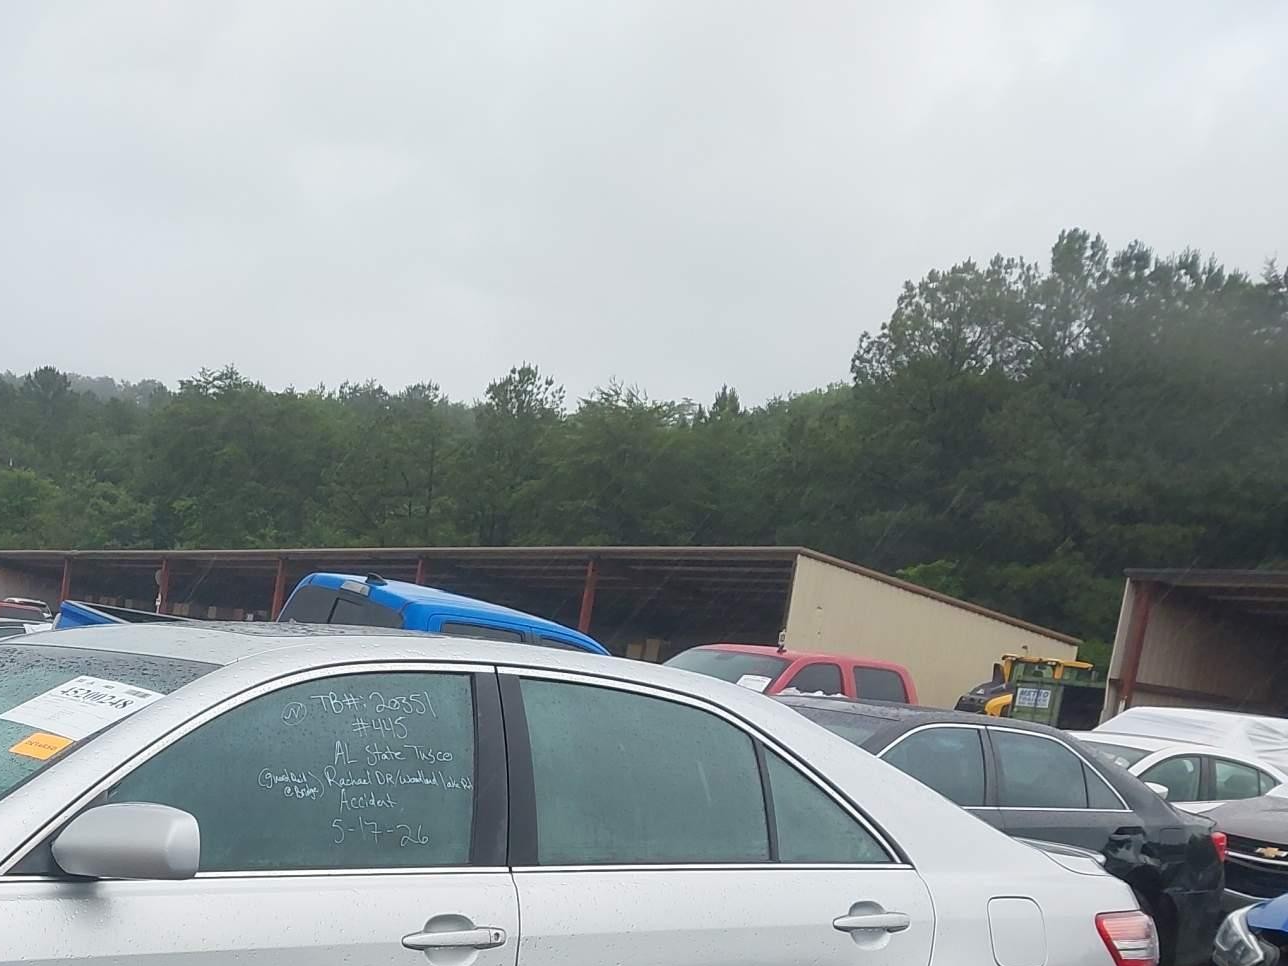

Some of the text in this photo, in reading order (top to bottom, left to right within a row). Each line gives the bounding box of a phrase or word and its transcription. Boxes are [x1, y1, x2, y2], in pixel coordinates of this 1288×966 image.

[369, 691, 438, 719] 20351
[351, 716, 408, 739] #445
[334, 740, 358, 765] AL
[365, 743, 406, 766] State
[339, 788, 398, 813] Accident
[331, 816, 430, 848] 5-17-26
